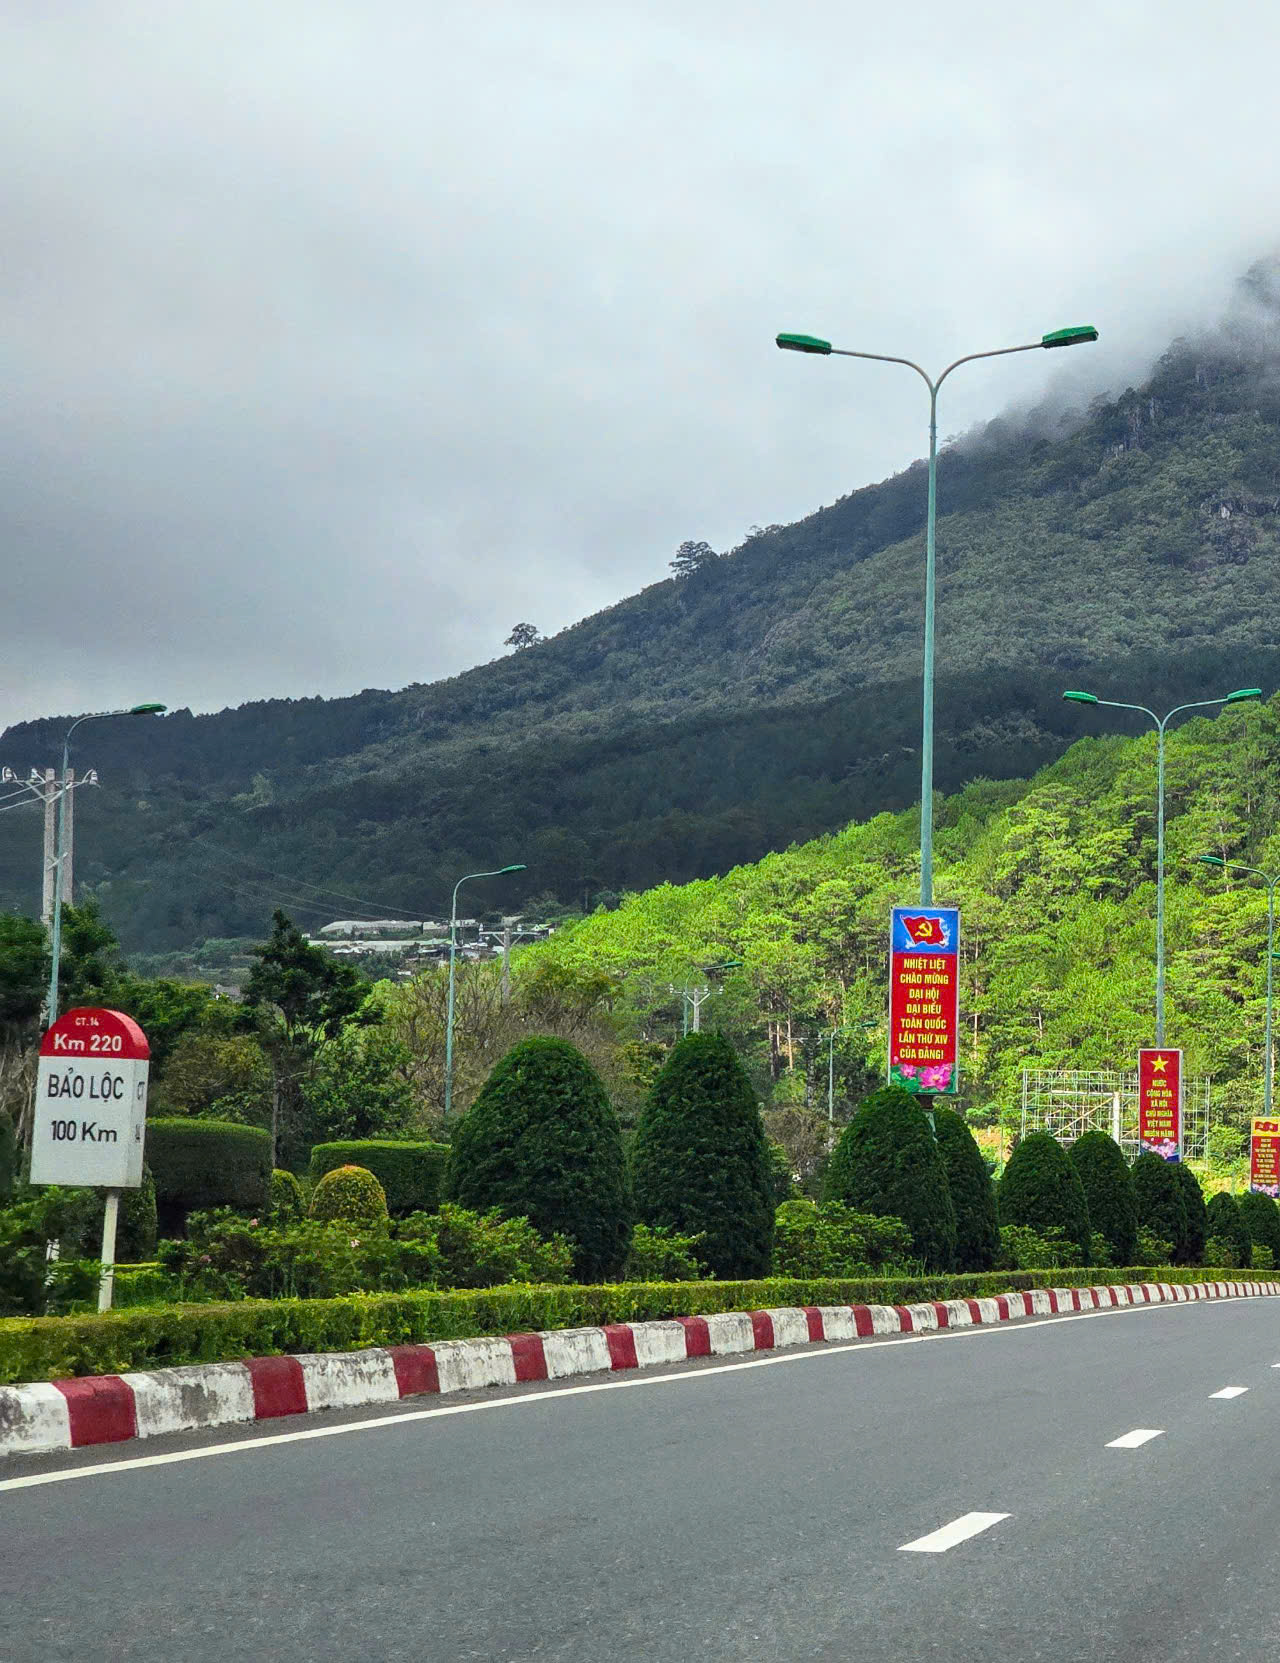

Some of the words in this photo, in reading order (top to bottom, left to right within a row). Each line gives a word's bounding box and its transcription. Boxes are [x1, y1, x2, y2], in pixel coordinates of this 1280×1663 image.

[903, 958, 927, 971] NHIỆT
[929, 959, 946, 971] LIỆT
[900, 972, 922, 984] CHÀO
[924, 972, 949, 985] MỪNG
[909, 988, 923, 1001] ĐẠI
[925, 987, 940, 1001] HỘI
[906, 1003, 921, 1016] ĐẠI
[922, 1001, 942, 1015] BIỂU
[901, 1016, 922, 1029] TOÀN
[924, 1016, 947, 1030] QUỐC
[54, 1033, 85, 1051] Km
[90, 1034, 122, 1052] 220
[934, 1034, 948, 1045] XIV
[900, 1046, 917, 1059] CỦA
[48, 1067, 84, 1099] BẢO
[89, 1072, 125, 1103] LỘC
[51, 1120, 77, 1142] 100
[82, 1122, 118, 1143] Km
